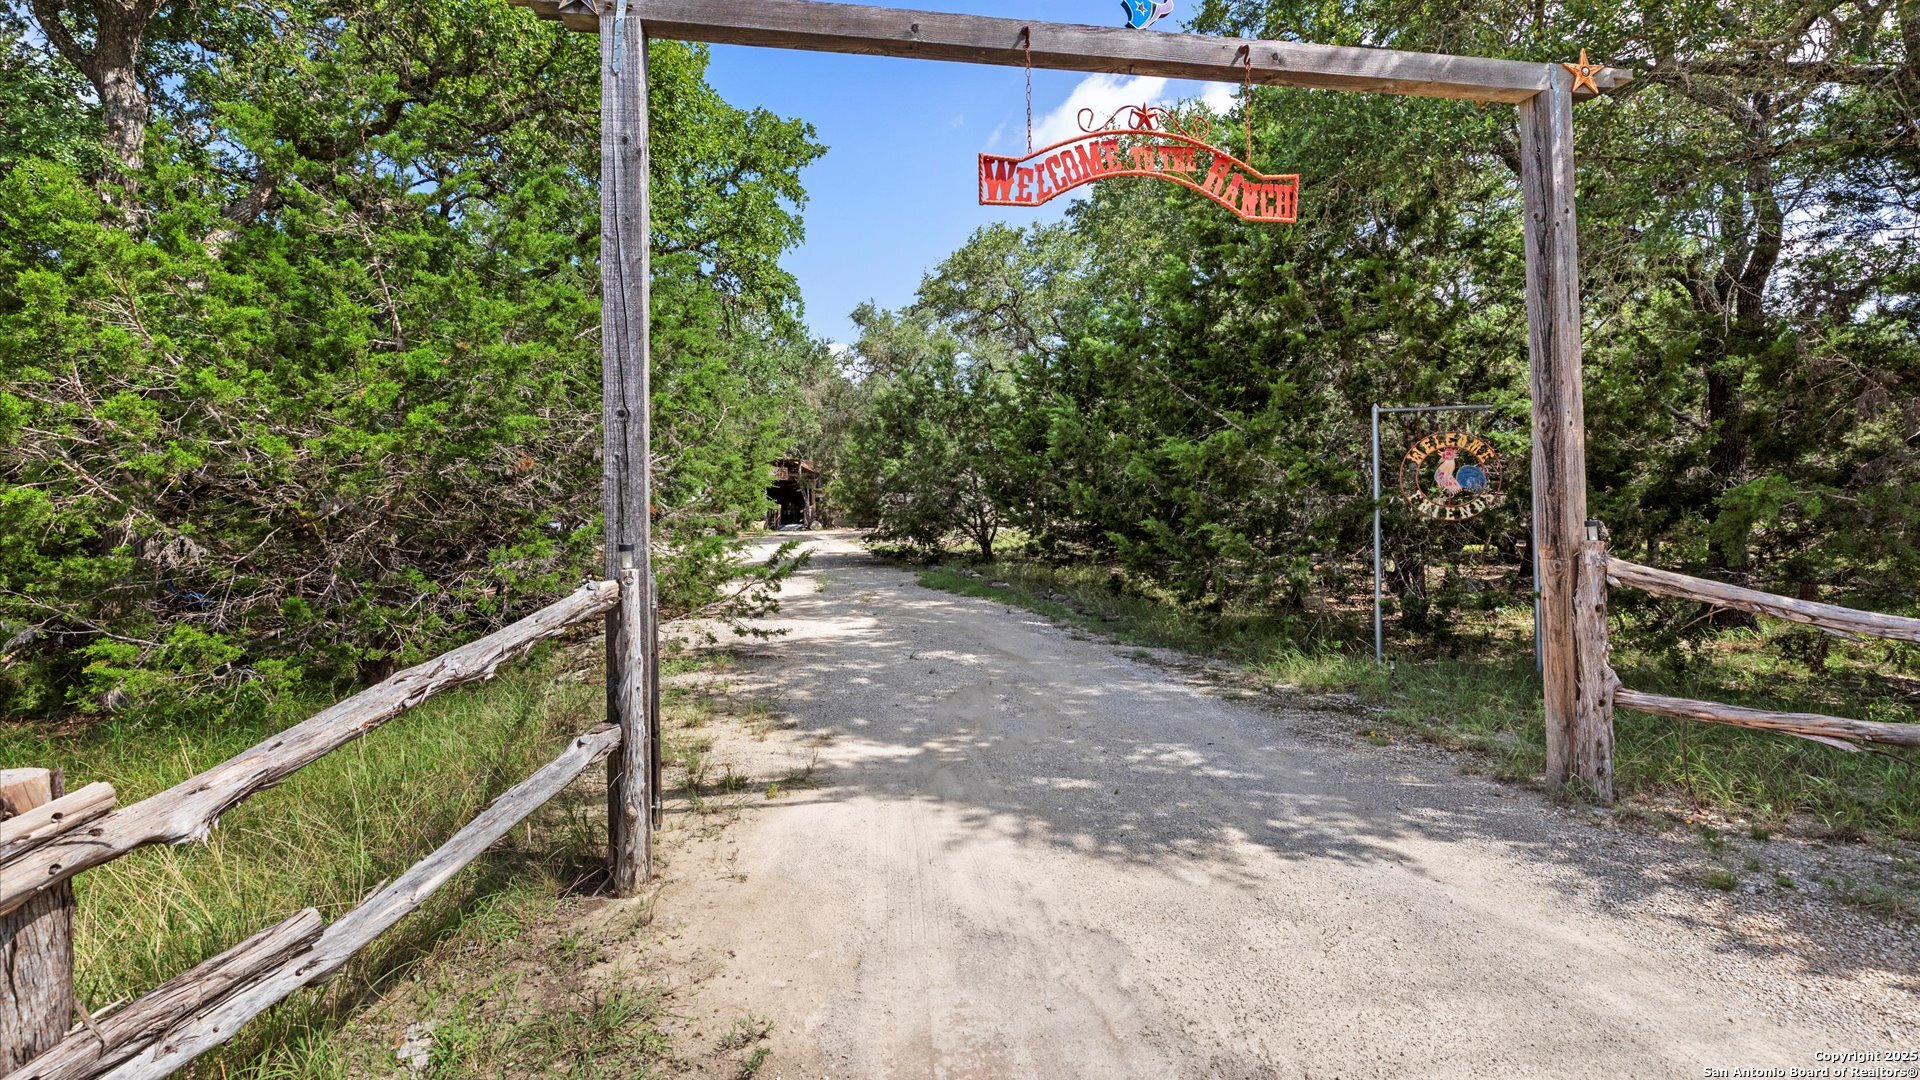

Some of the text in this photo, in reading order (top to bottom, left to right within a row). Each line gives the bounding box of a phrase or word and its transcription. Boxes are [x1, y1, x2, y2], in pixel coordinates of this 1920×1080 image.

[983, 139, 1293, 217] WELCOME TO THE RANCH
[1407, 432, 1495, 464] WELCOME
